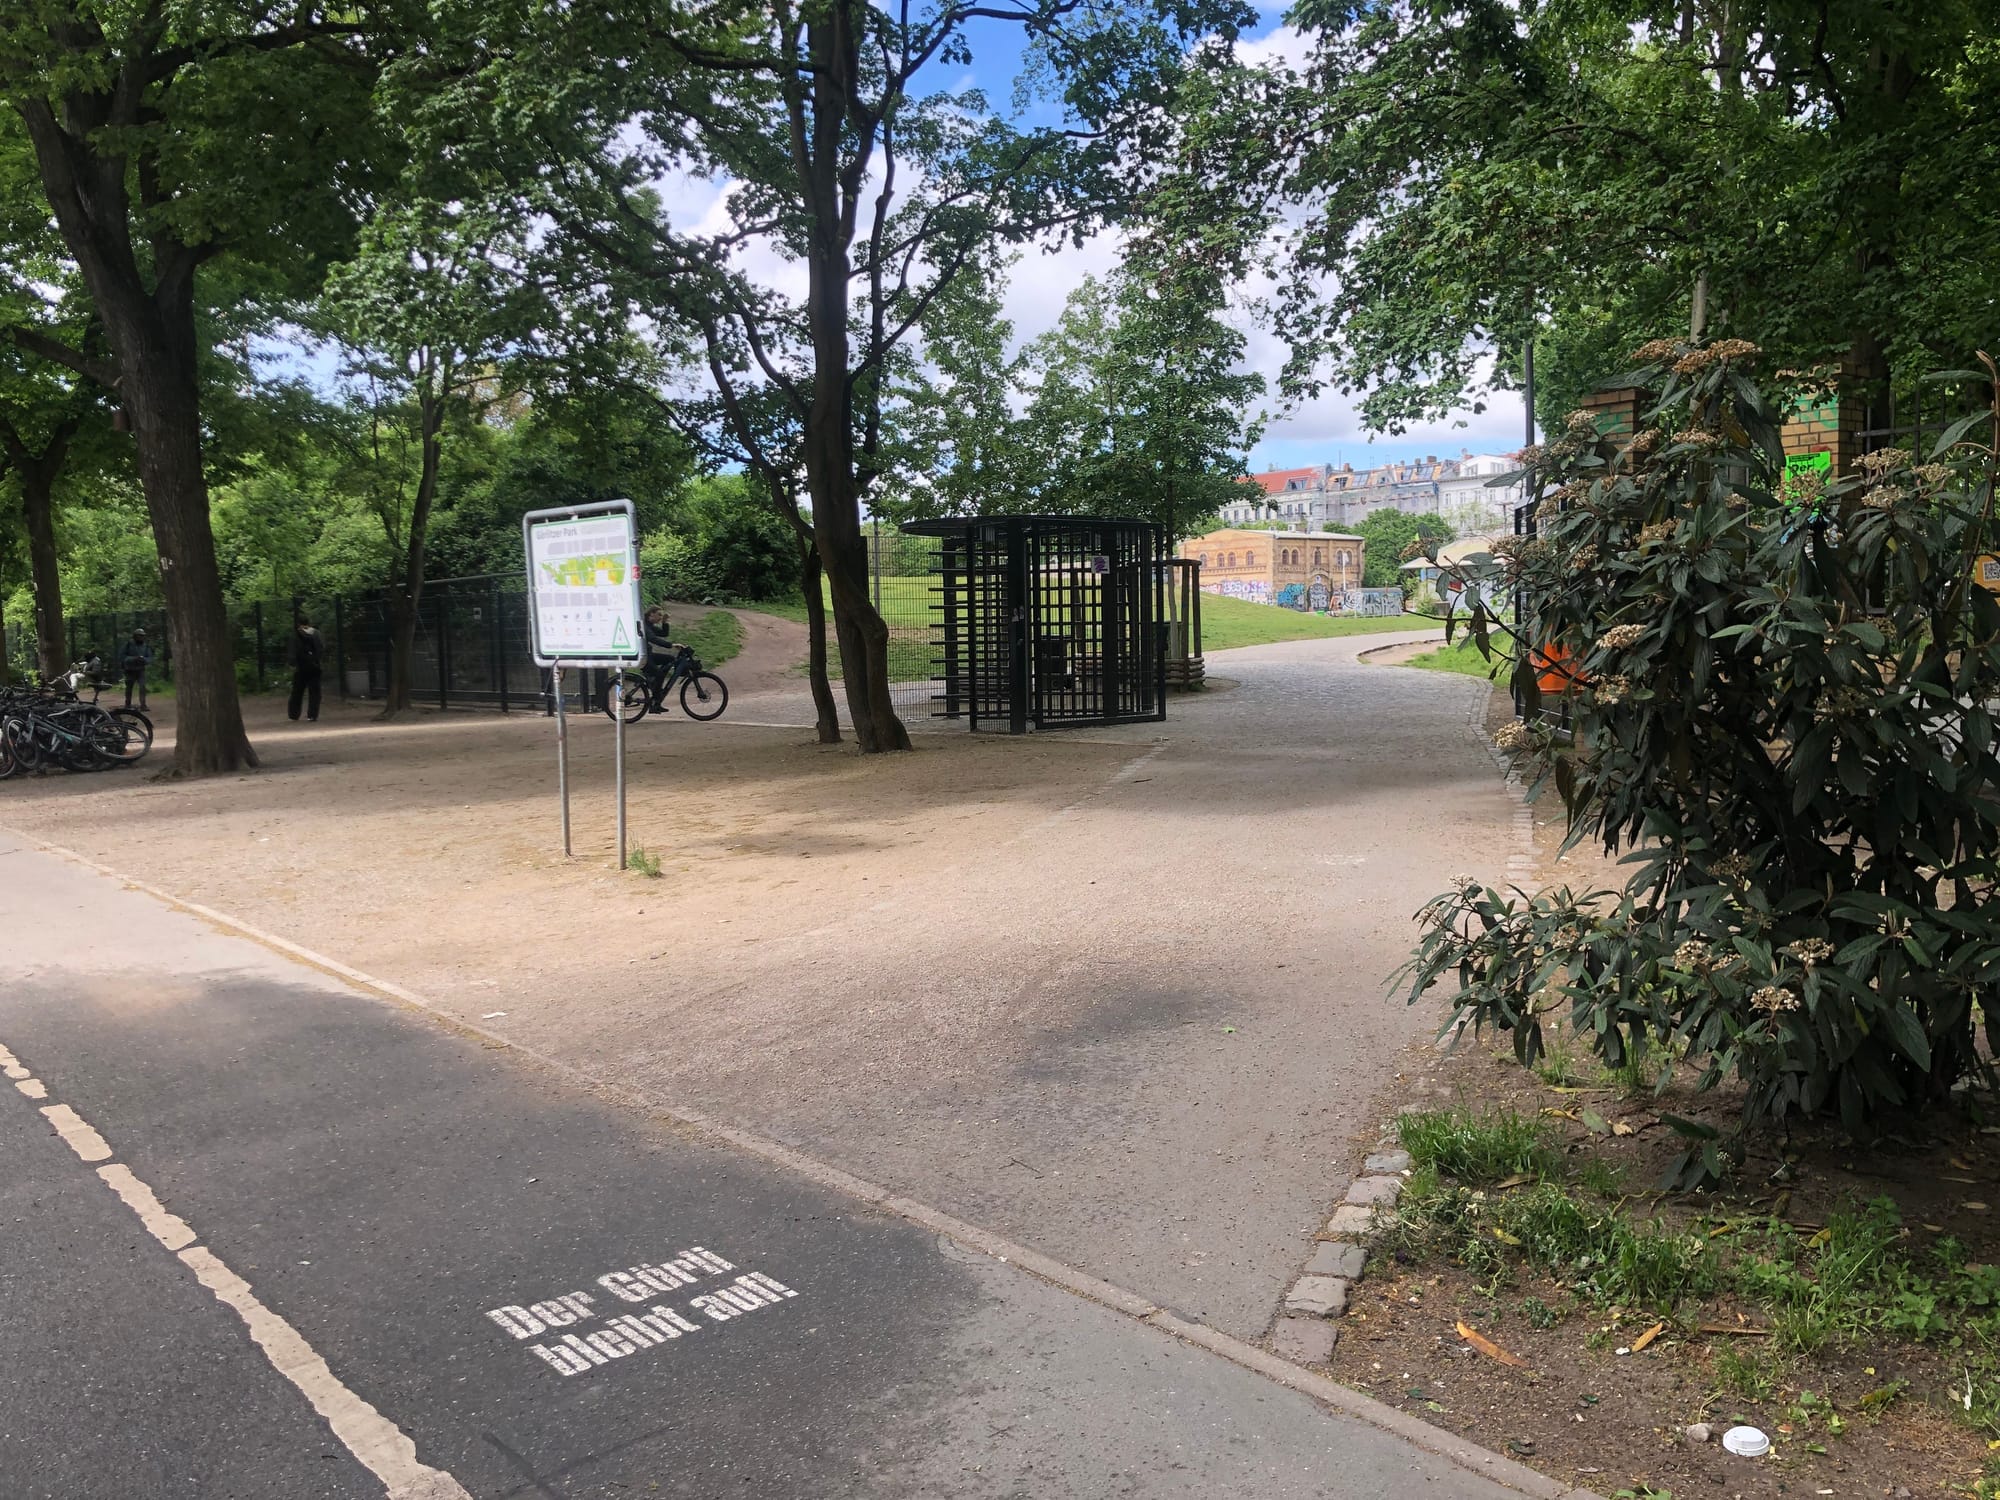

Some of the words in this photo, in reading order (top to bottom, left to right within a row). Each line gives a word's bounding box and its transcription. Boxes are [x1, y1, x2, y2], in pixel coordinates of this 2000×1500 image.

[563, 527, 578, 537] Park
[484, 1291, 596, 1339] Der
[597, 1246, 736, 1301] Görli
[529, 1305, 702, 1376] bleibt
[690, 1271, 799, 1320] auf!
